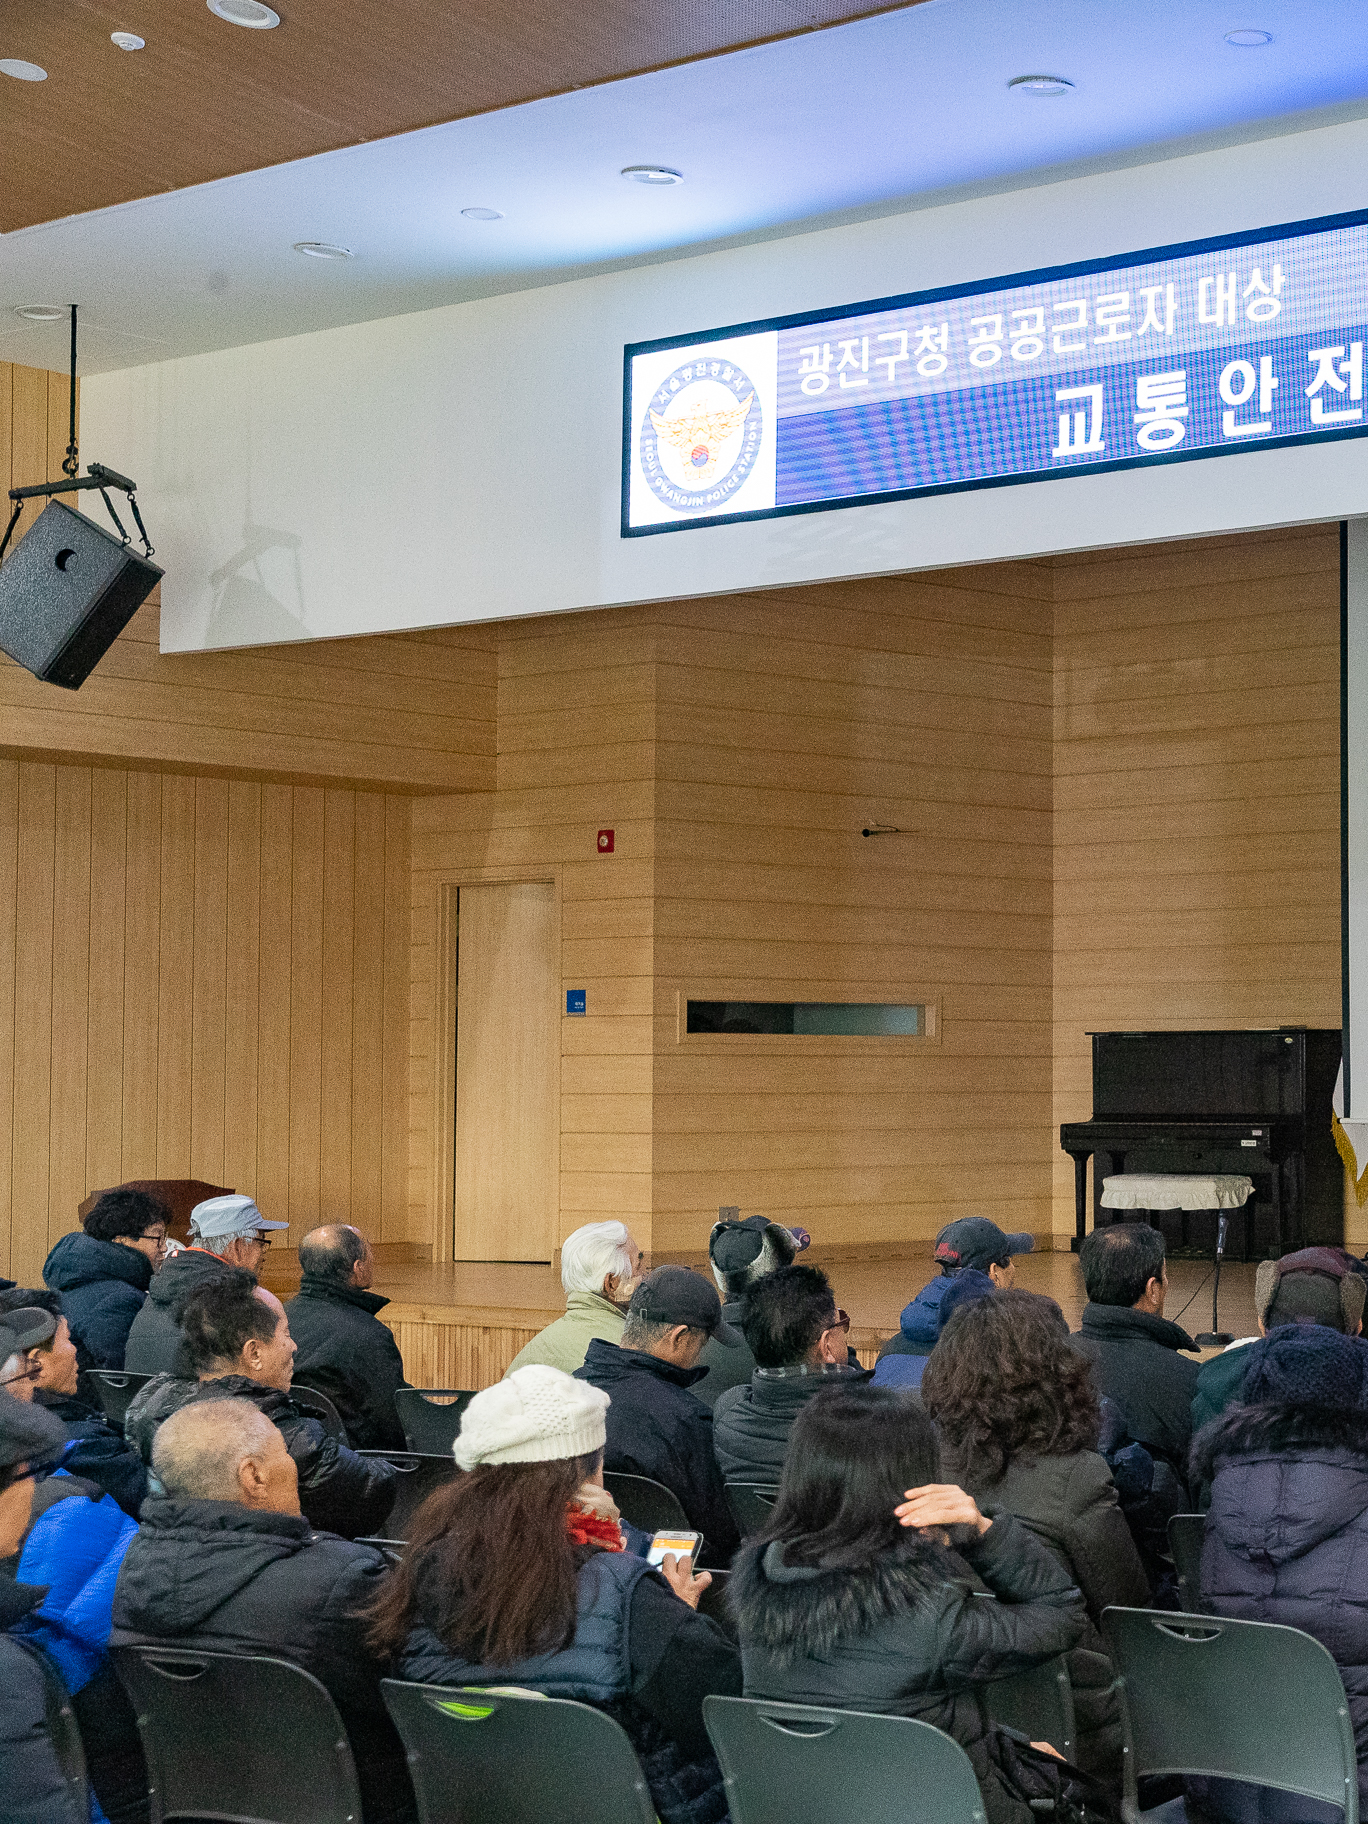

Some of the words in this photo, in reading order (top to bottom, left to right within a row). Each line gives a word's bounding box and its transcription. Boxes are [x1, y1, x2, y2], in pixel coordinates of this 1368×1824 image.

[798, 322, 949, 395] 광진구청
[968, 282, 1179, 367] 공공근로자
[1198, 263, 1286, 329] 대상
